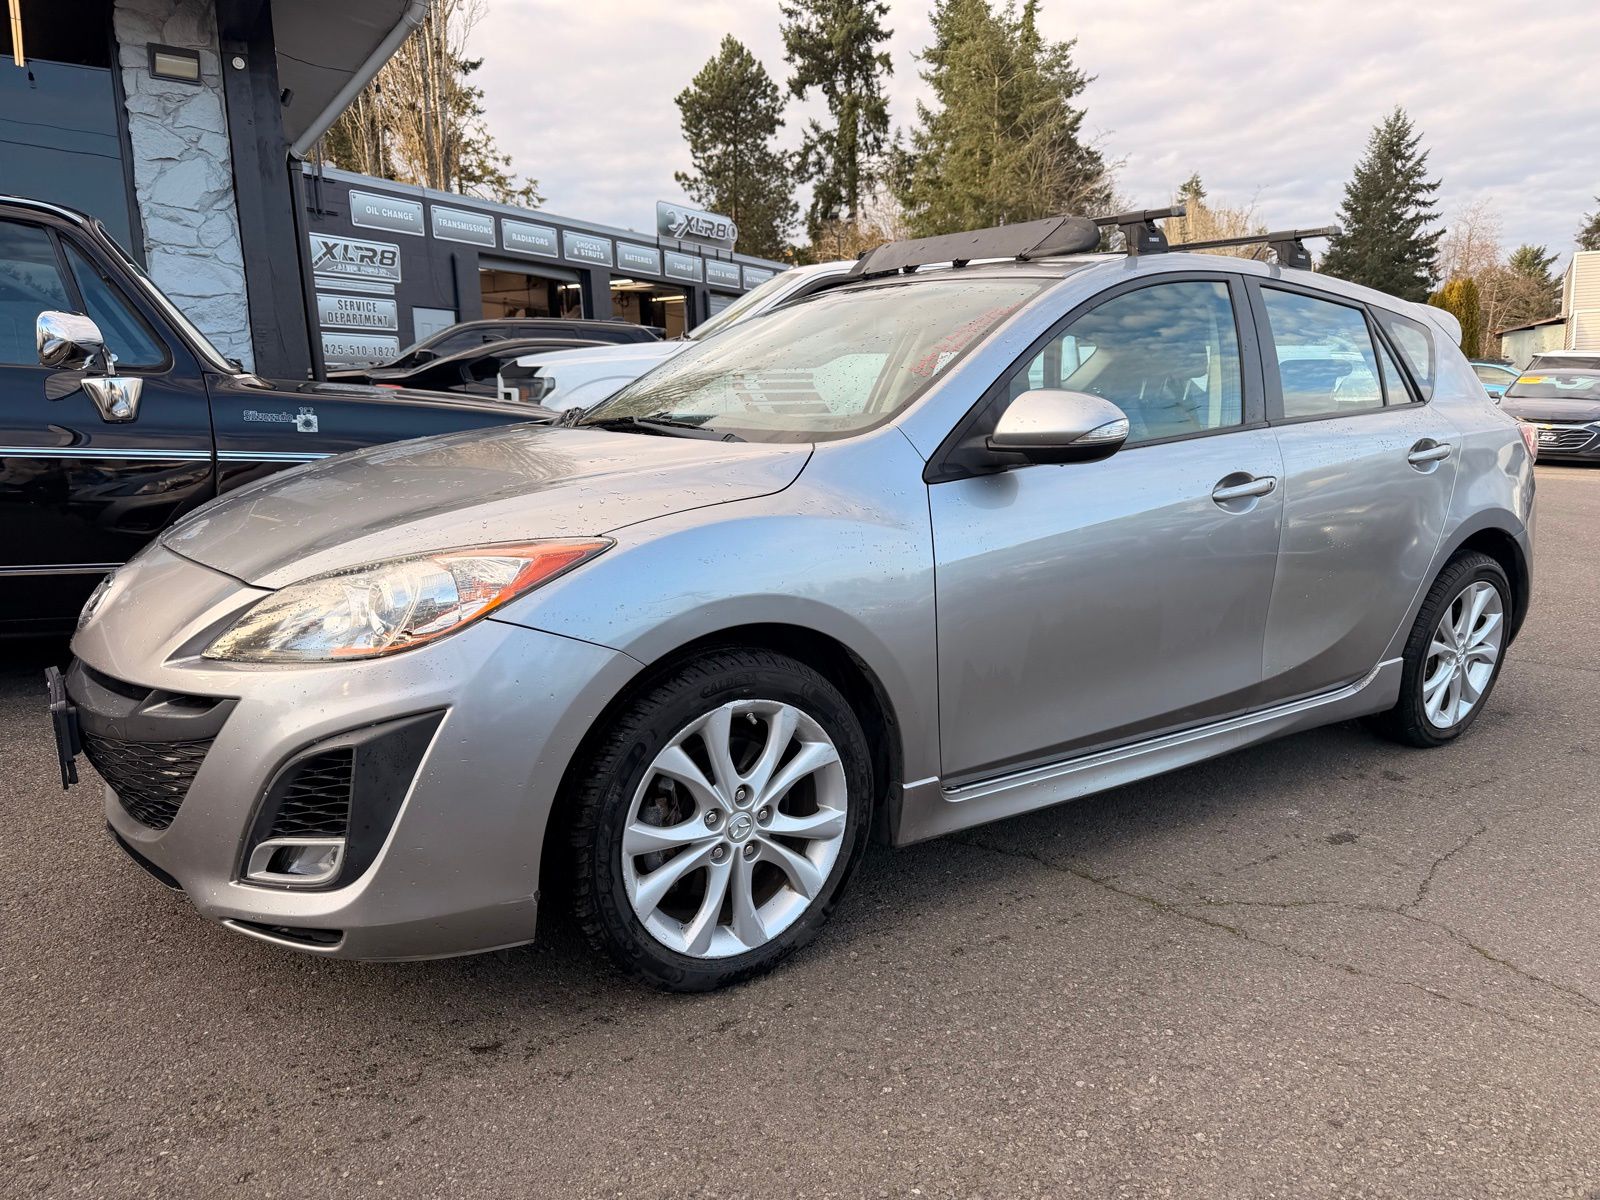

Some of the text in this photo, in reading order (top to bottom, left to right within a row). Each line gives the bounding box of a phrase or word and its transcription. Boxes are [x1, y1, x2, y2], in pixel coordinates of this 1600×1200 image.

[366, 205, 414, 221] OIL CHANGE
[438, 218, 492, 235] TRANSMISSIONS
[512, 232, 549, 246] RADIATORS
[576, 240, 601, 251] SHOCKS
[313, 241, 397, 266] XLR8
[581, 248, 604, 259] STRUTS
[337, 299, 377, 313] SERVICE
[328, 311, 388, 326] DEPARTMENT
[324, 343, 396, 357] 425-510-1822
[243, 409, 293, 423] Silverado
